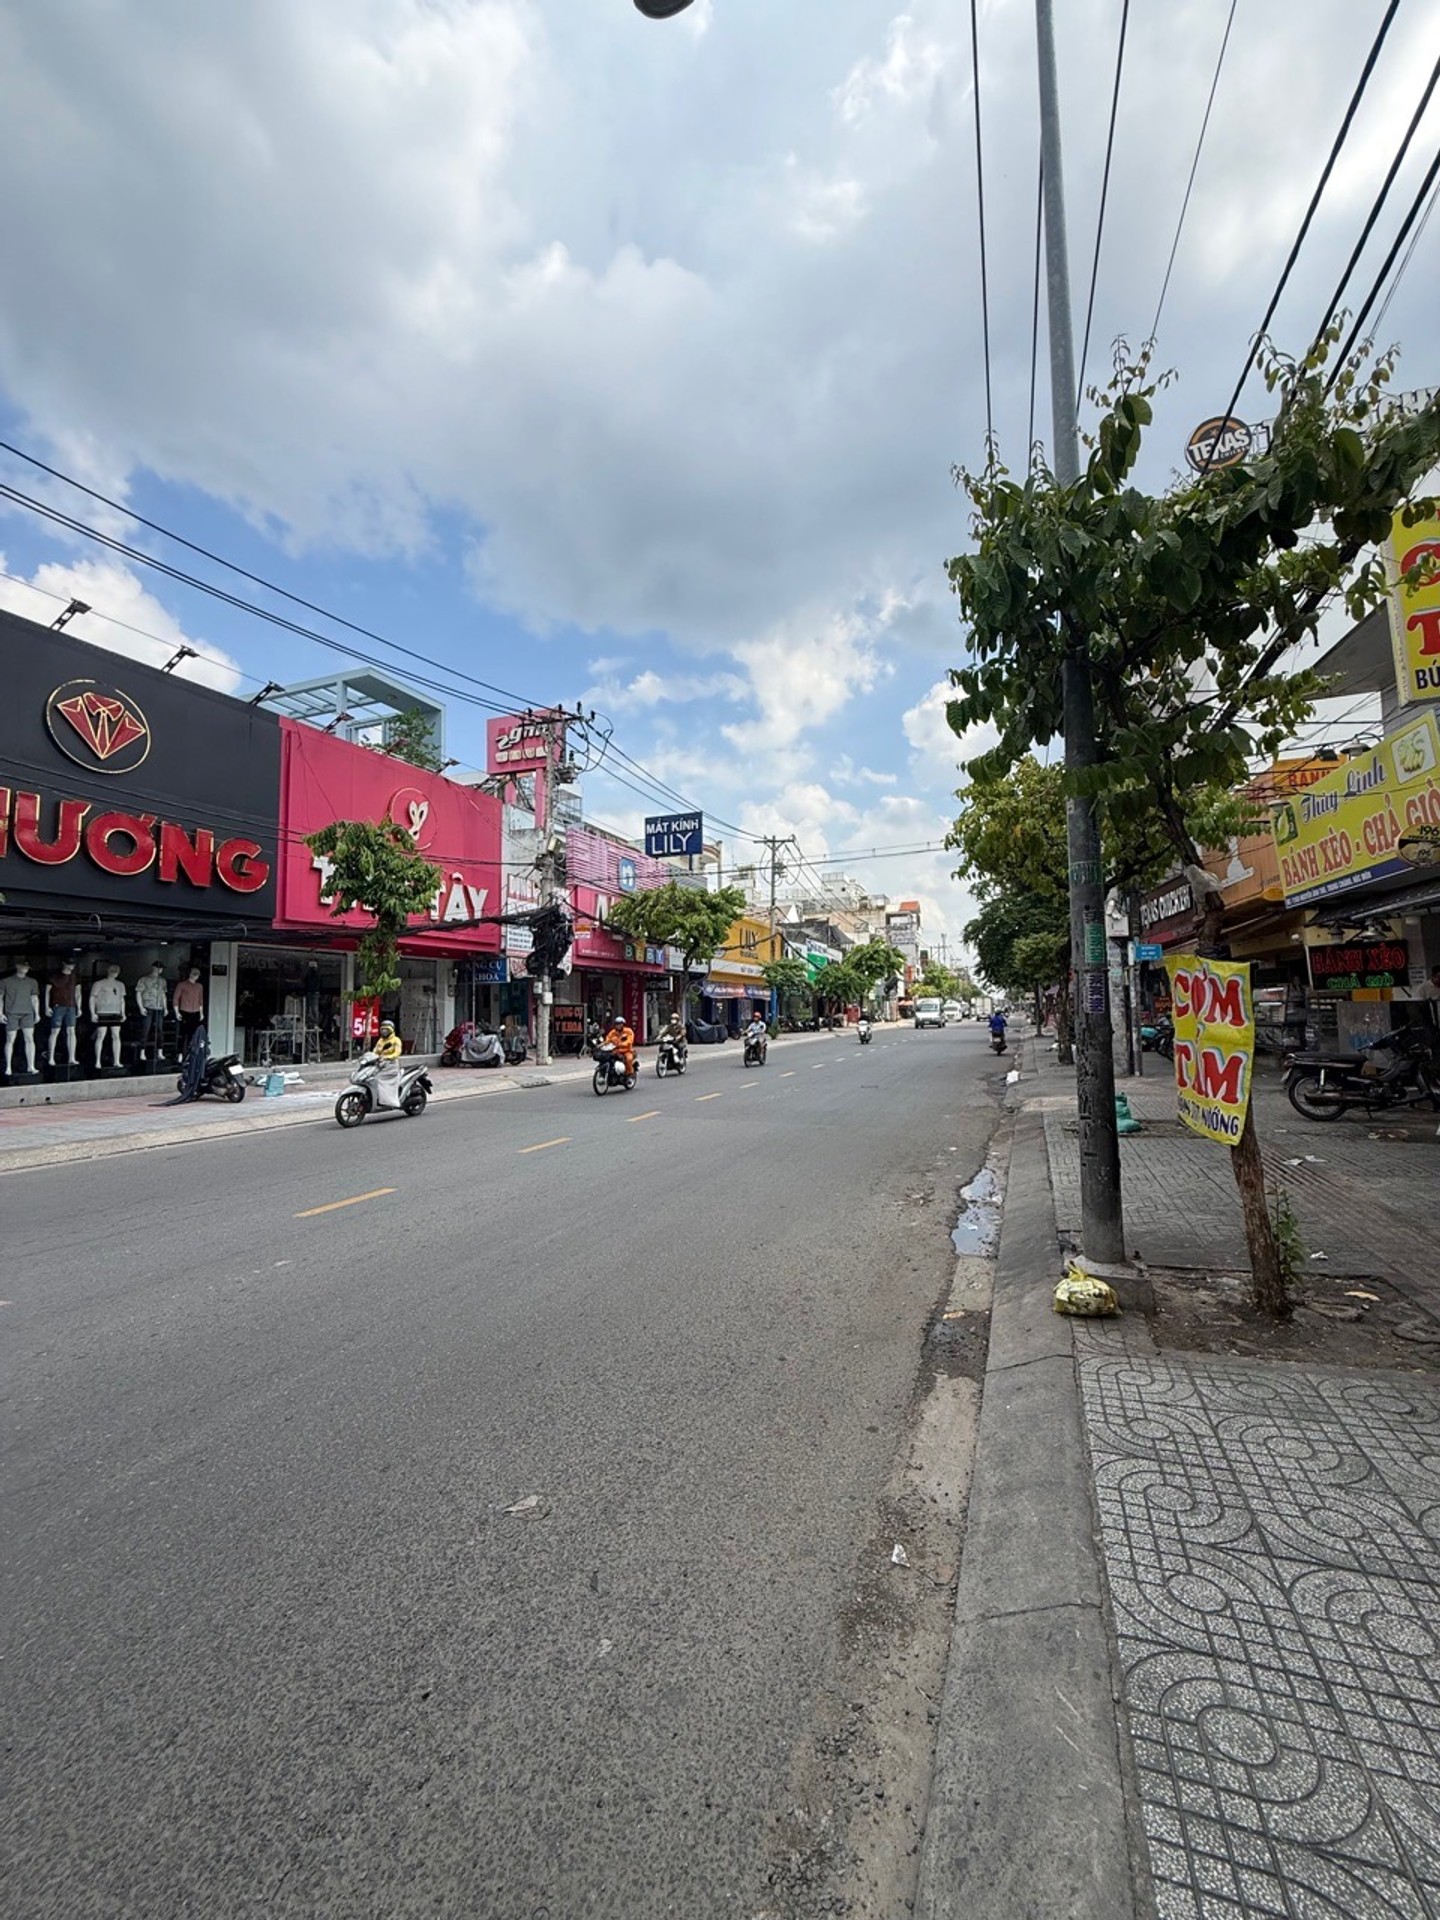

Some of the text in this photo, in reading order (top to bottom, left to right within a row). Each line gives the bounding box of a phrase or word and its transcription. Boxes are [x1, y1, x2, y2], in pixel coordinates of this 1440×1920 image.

[1189, 428, 1251, 462] TEXAS
[0, 787, 270, 893] ƯƠNG
[652, 832, 692, 854] LILY
